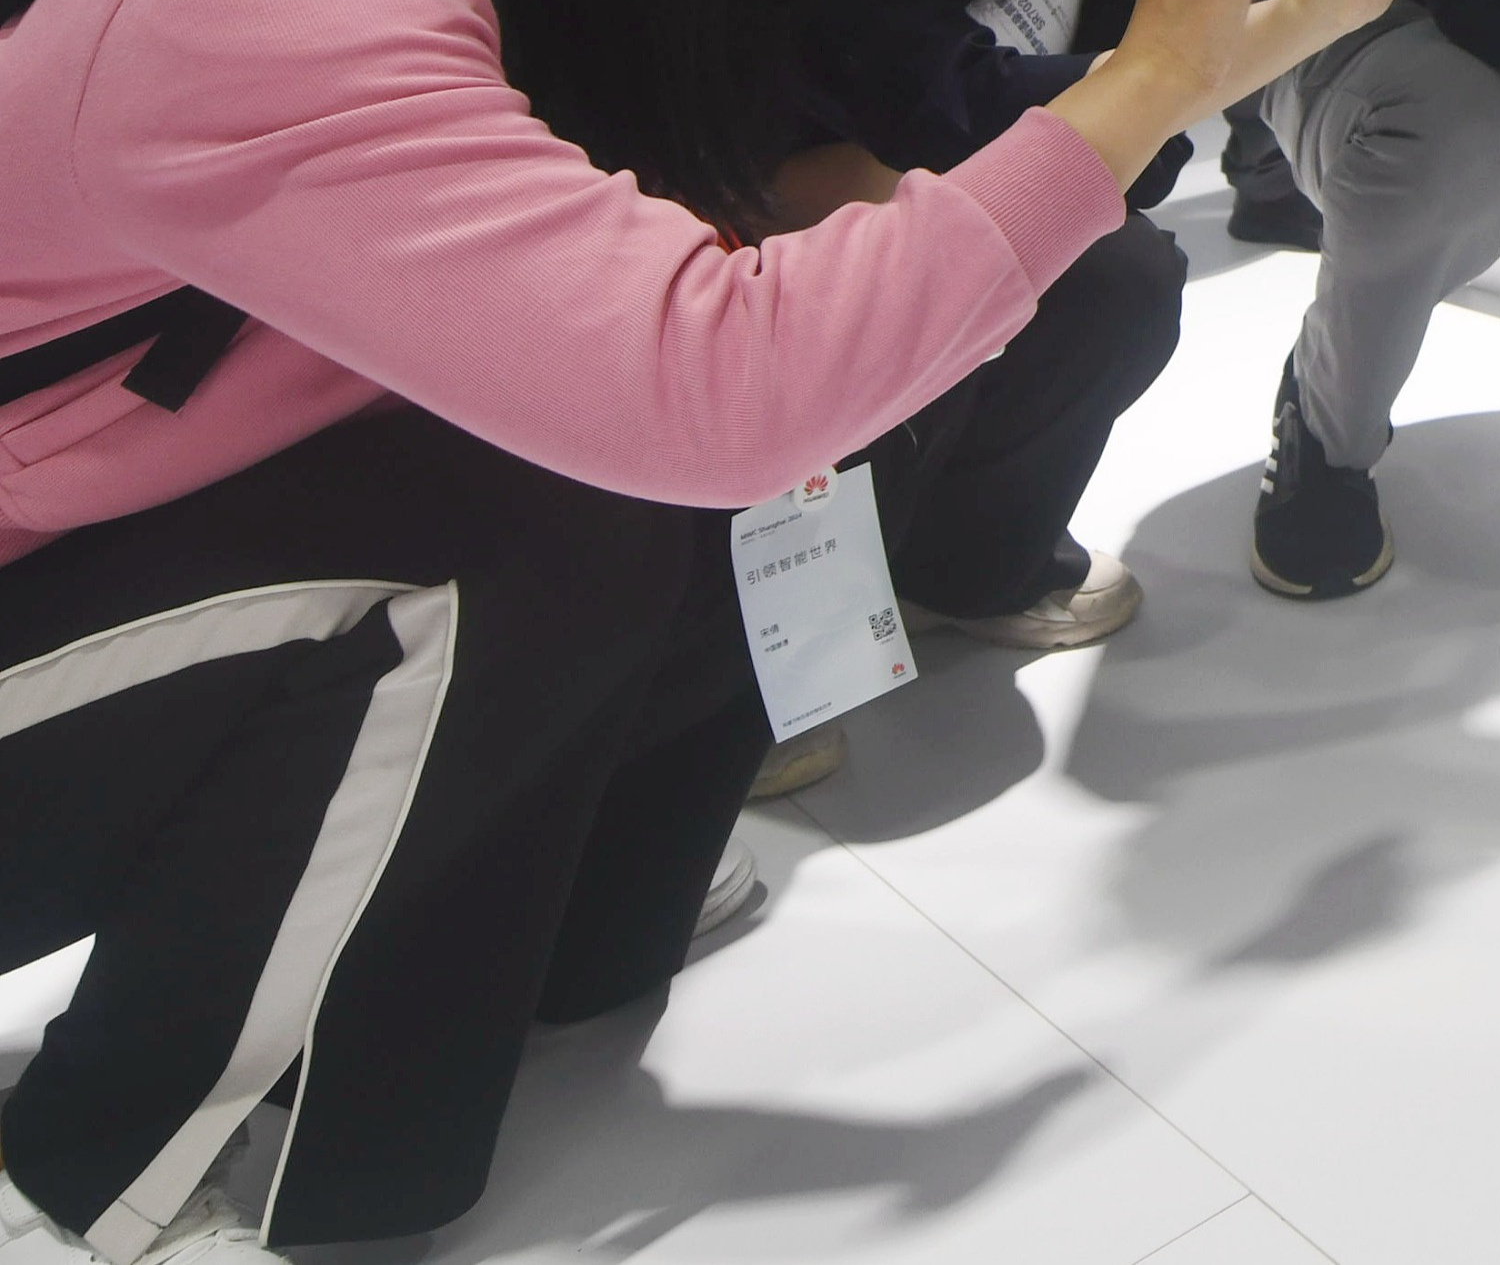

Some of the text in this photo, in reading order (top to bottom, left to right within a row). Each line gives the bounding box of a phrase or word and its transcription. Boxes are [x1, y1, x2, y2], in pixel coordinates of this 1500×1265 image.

[746, 538, 838, 585] 引领智能世界
